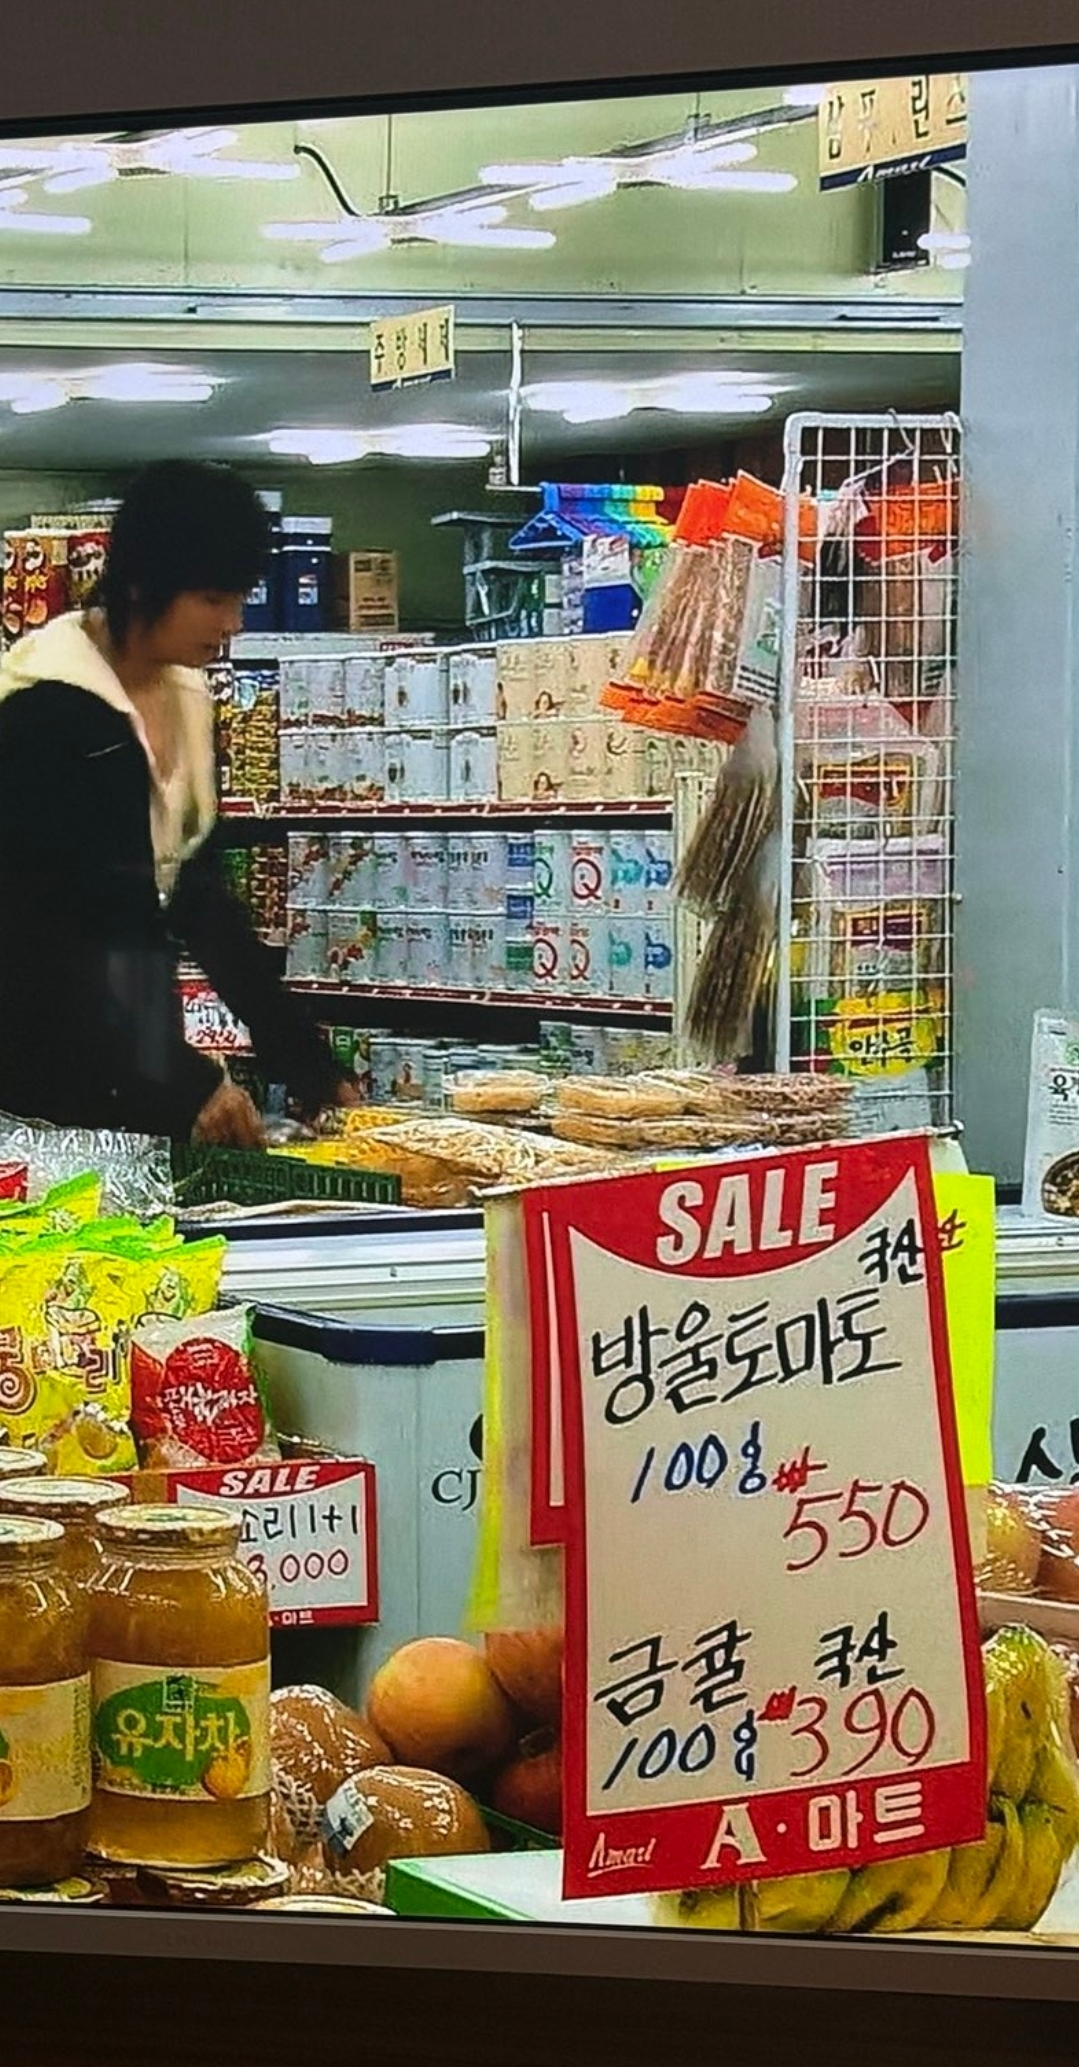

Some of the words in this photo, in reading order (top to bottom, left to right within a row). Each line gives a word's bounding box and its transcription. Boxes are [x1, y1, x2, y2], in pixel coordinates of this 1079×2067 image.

[656, 1161, 839, 1266] SALE
[591, 1287, 903, 1425] 방울토마토
[219, 1465, 321, 1496] SALE
[431, 1468, 483, 1512] CJ
[111, 1709, 250, 1762] 유자차
